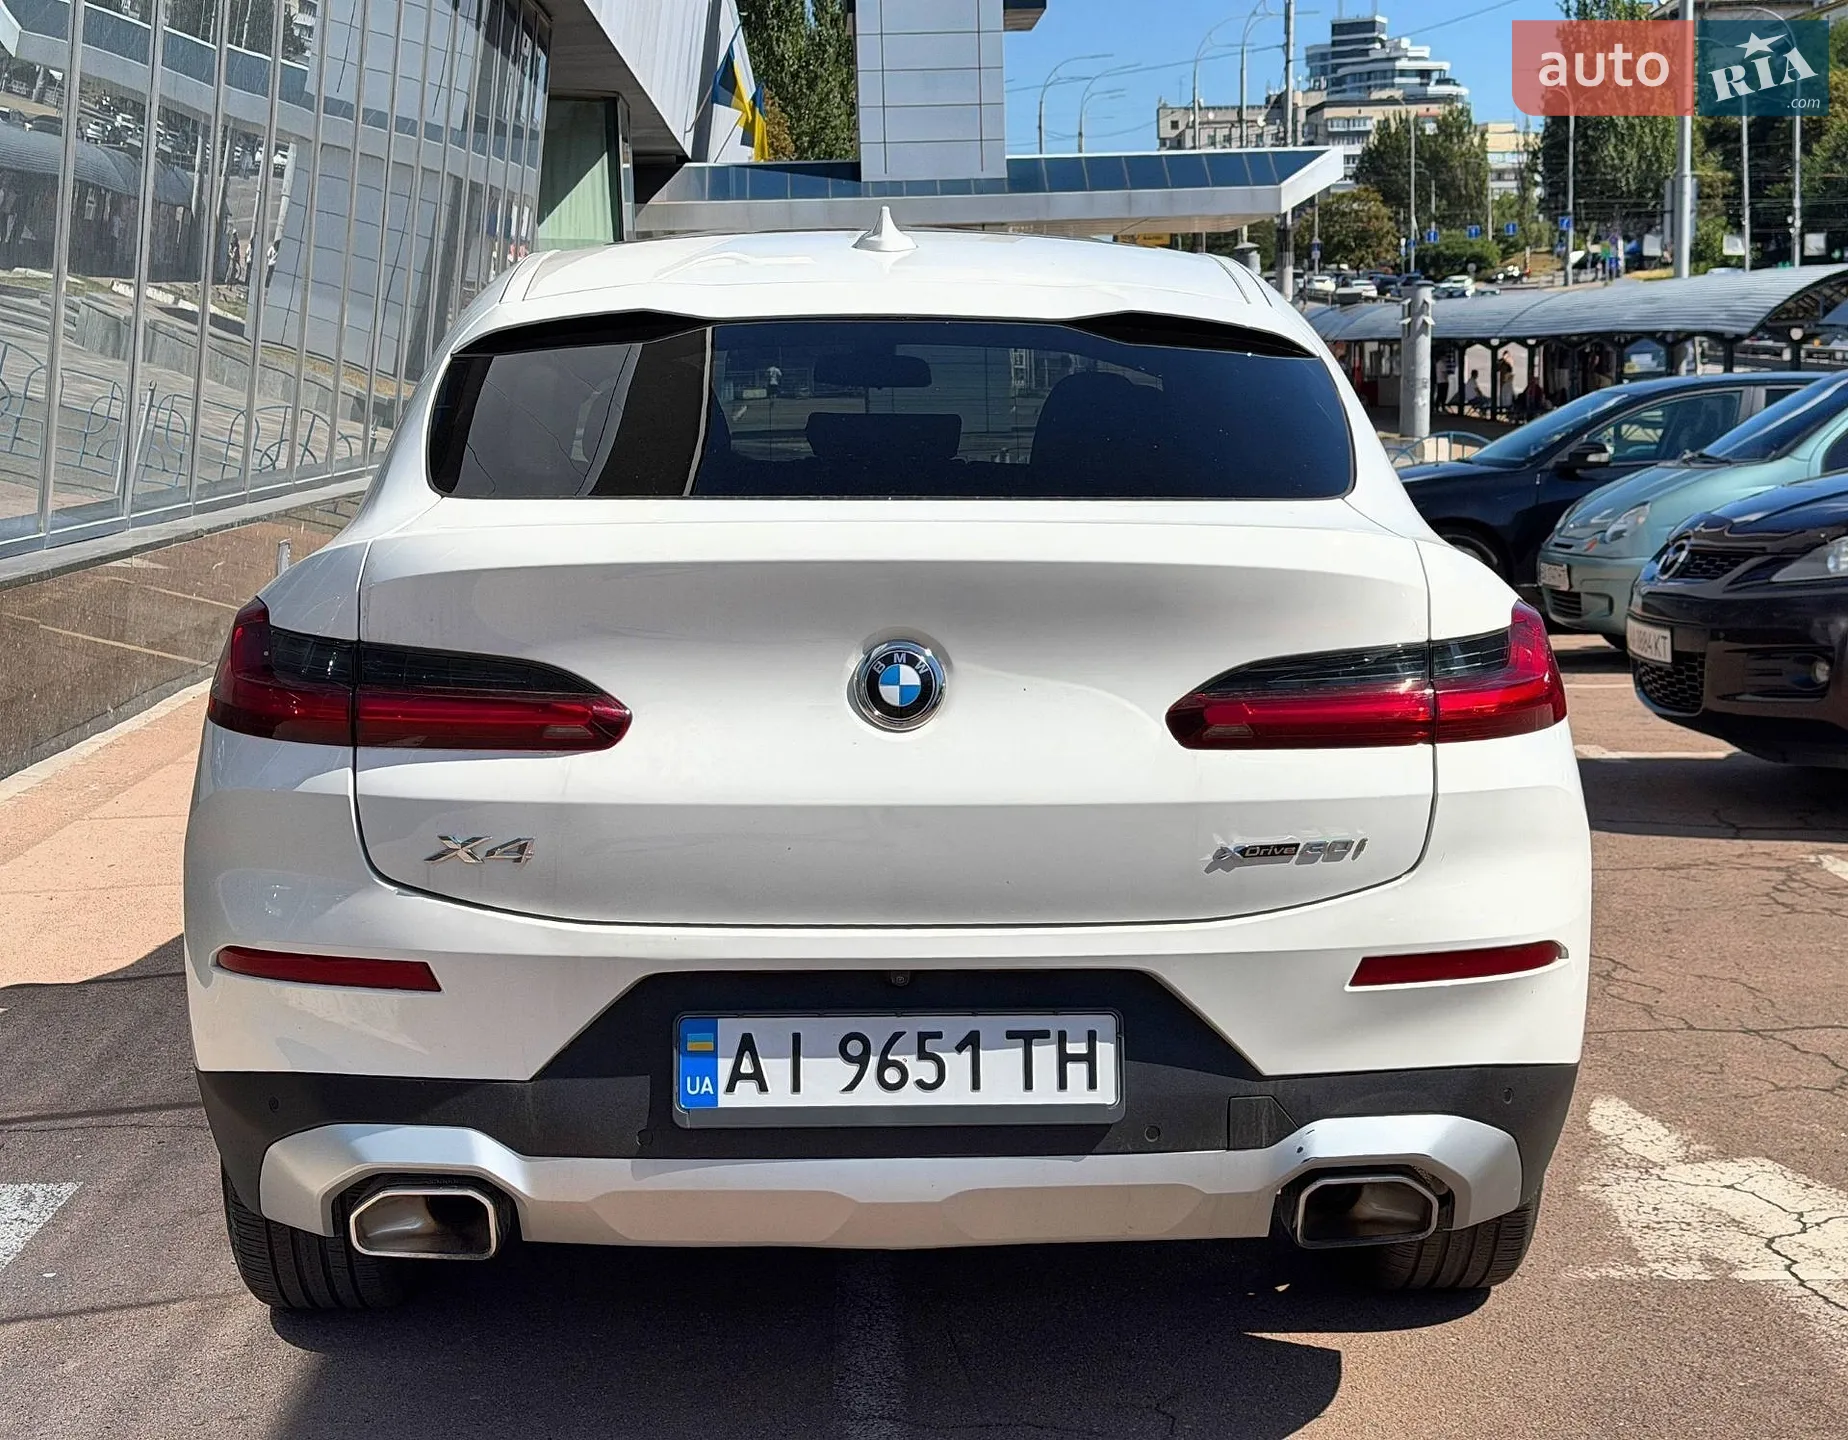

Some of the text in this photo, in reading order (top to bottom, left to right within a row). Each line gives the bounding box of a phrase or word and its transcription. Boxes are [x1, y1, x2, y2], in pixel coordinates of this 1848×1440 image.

[871, 652, 929, 675] BMW
[424, 835, 536, 864] X4
[723, 1029, 1098, 1095] AI 9651 TH
[686, 1077, 714, 1095] UA
